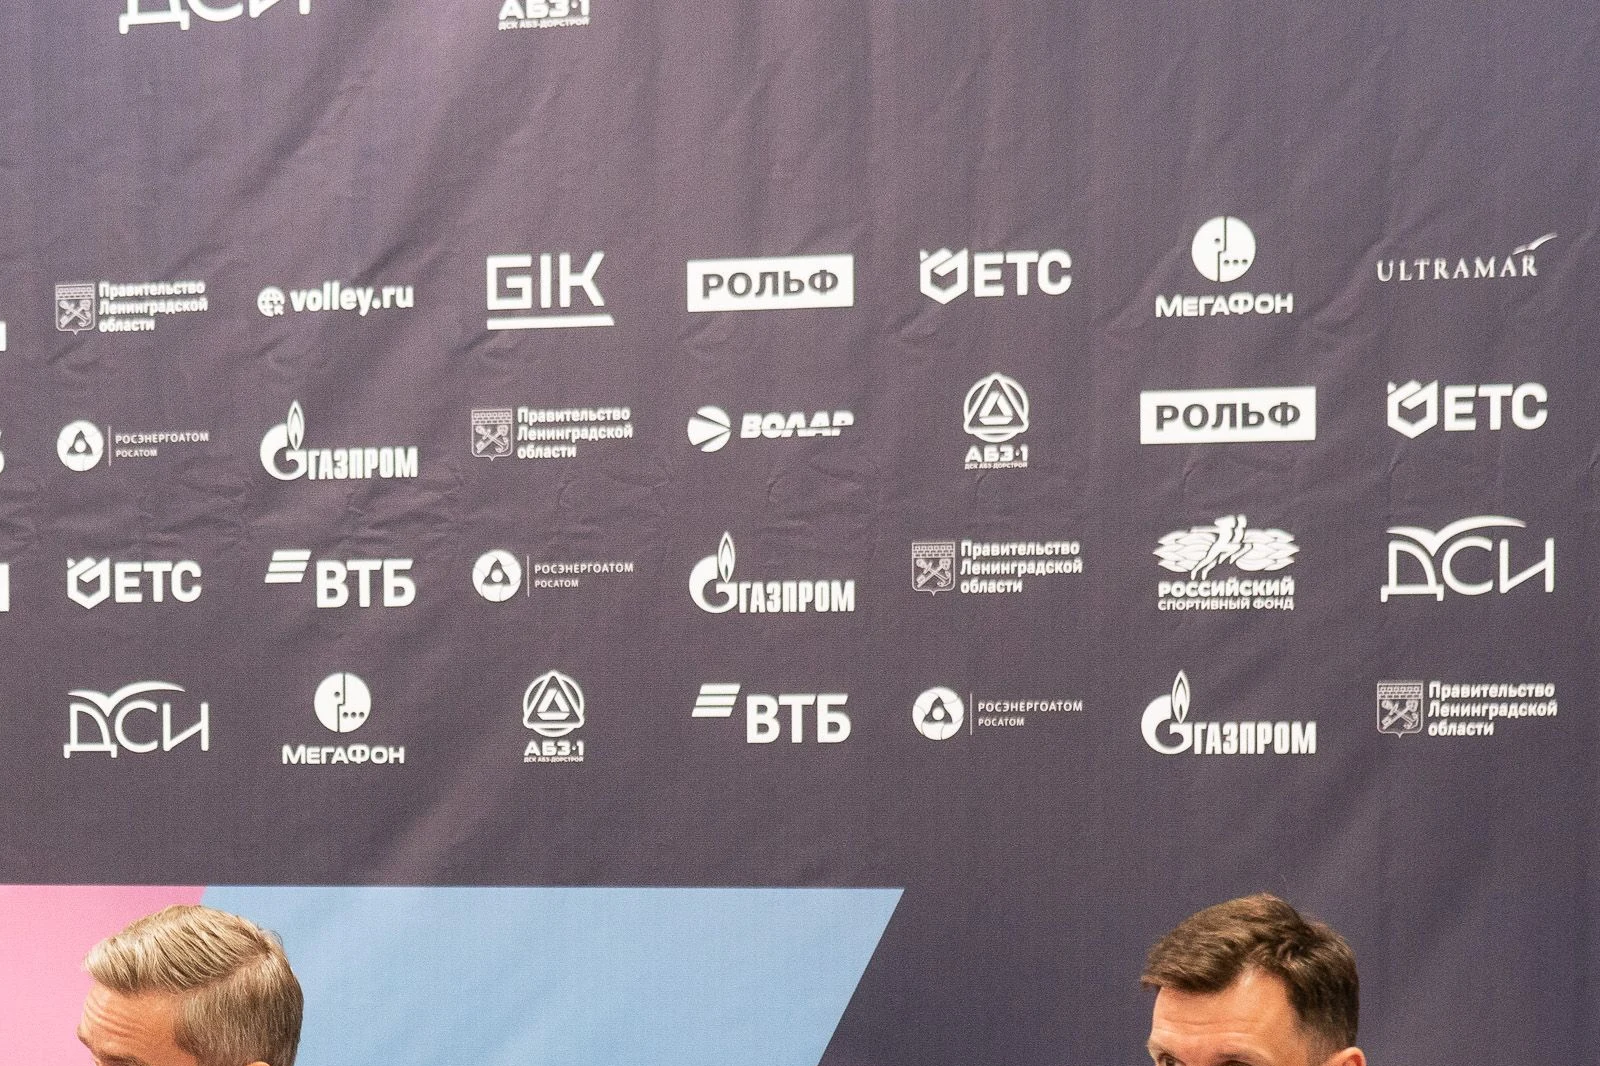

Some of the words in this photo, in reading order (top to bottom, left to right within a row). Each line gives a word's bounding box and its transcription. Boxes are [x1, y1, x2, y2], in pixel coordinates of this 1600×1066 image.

[1376, 255, 1538, 282] ULTRAMAR
[98, 280, 206, 300] Правительство
[486, 251, 605, 311] GIK
[702, 269, 839, 299] РОЛЬФ
[98, 295, 208, 315] Ленинградской
[289, 280, 414, 317] volley.ru
[98, 316, 155, 333] области
[517, 406, 631, 425] Правительство
[1155, 401, 1301, 431] РОЛЬФ
[114, 431, 210, 444] РОСЭНЕРГОАТОМ
[517, 423, 634, 443] Ленинградской
[115, 448, 158, 458] РОСАТОМ
[517, 443, 577, 459] области
[305, 446, 418, 480] ГАЗПРОМ
[960, 539, 1080, 558] Правительство
[534, 561, 634, 574] РОСЭНЕРГОАТОМ
[959, 556, 1083, 577] Ленинградской
[1380, 534, 1555, 603] ДСИ
[316, 558, 416, 608] ВТБ
[534, 578, 579, 588] РОСАТОМ
[960, 577, 1023, 594] области
[1158, 575, 1295, 598] РОССИЙСКИЙ
[738, 580, 855, 614] ГАЗПРОМ
[1157, 596, 1251, 611] СПОРТИВНЫЙ
[1252, 596, 1295, 611] ФОНД
[1428, 681, 1555, 701] Правительство
[977, 700, 1083, 713] РОСЭНЕРГОАТОМ
[1427, 699, 1558, 720] Ленинградской
[746, 693, 852, 744] ВТБ
[977, 716, 1025, 727] РОСАТОМ
[1427, 718, 1495, 737] области
[63, 699, 210, 759] ДСИ
[1190, 721, 1317, 755] ГАЗПРОМ
